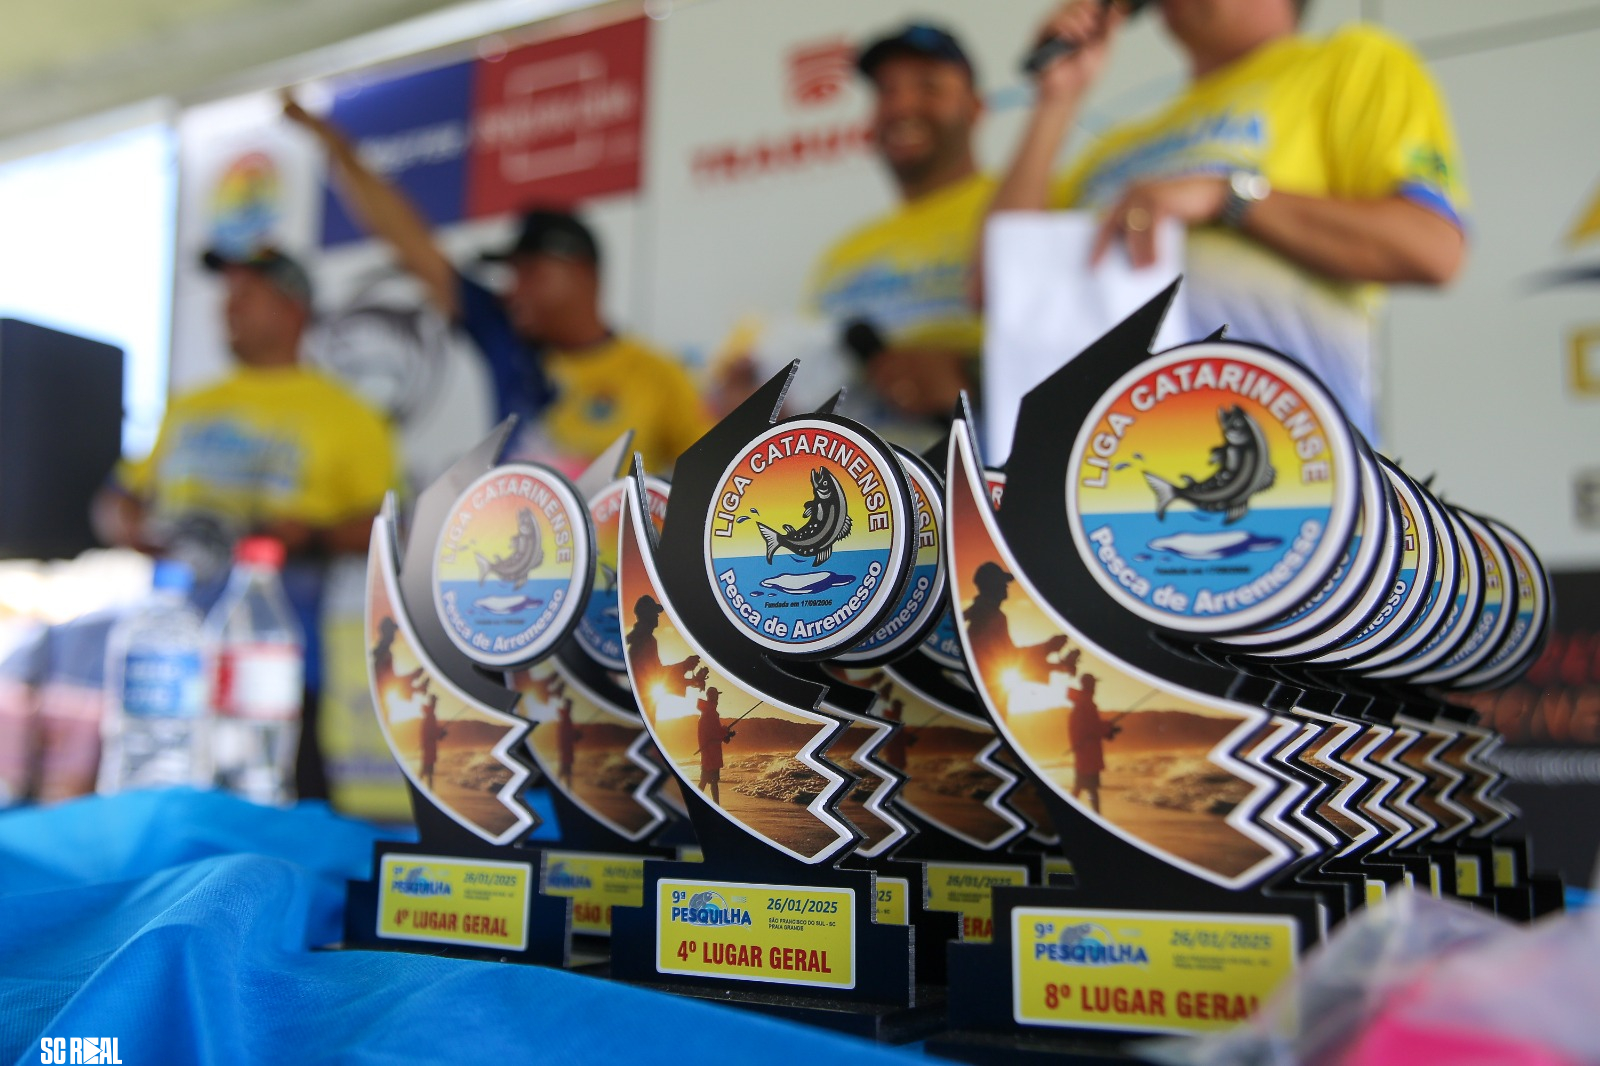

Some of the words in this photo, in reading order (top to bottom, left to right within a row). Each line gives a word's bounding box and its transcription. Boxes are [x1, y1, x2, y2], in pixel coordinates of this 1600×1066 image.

[1083, 411, 1135, 488] LIGA
[1130, 363, 1329, 483] CATARINENSE
[714, 475, 752, 538] LIGA
[750, 434, 889, 532] CATARINENSE
[441, 510, 472, 564] LIGA
[471, 477, 572, 563] CATARINENSE
[1089, 525, 1151, 598] Pesca
[1153, 584, 1188, 612] de
[1192, 519, 1322, 614] Arremesso
[442, 590, 473, 640] Pesca
[472, 631, 491, 651] de
[493, 587, 566, 652] Arremesso
[719, 568, 763, 626] Pesca
[763, 616, 789, 638] de
[792, 560, 883, 639] Arremesso
[412, 909, 458, 932] LUGAR
[463, 914, 509, 938] GERAL
[671, 906, 752, 926] PESQUILHA
[766, 897, 838, 914] 26/01/2025
[677, 940, 697, 961] 4º
[703, 941, 763, 968] LUGAR
[769, 946, 832, 974] GERAL
[1034, 943, 1149, 965] PESQUILHA
[1045, 983, 1071, 1009] 8º
[1081, 985, 1166, 1017] LUGAR
